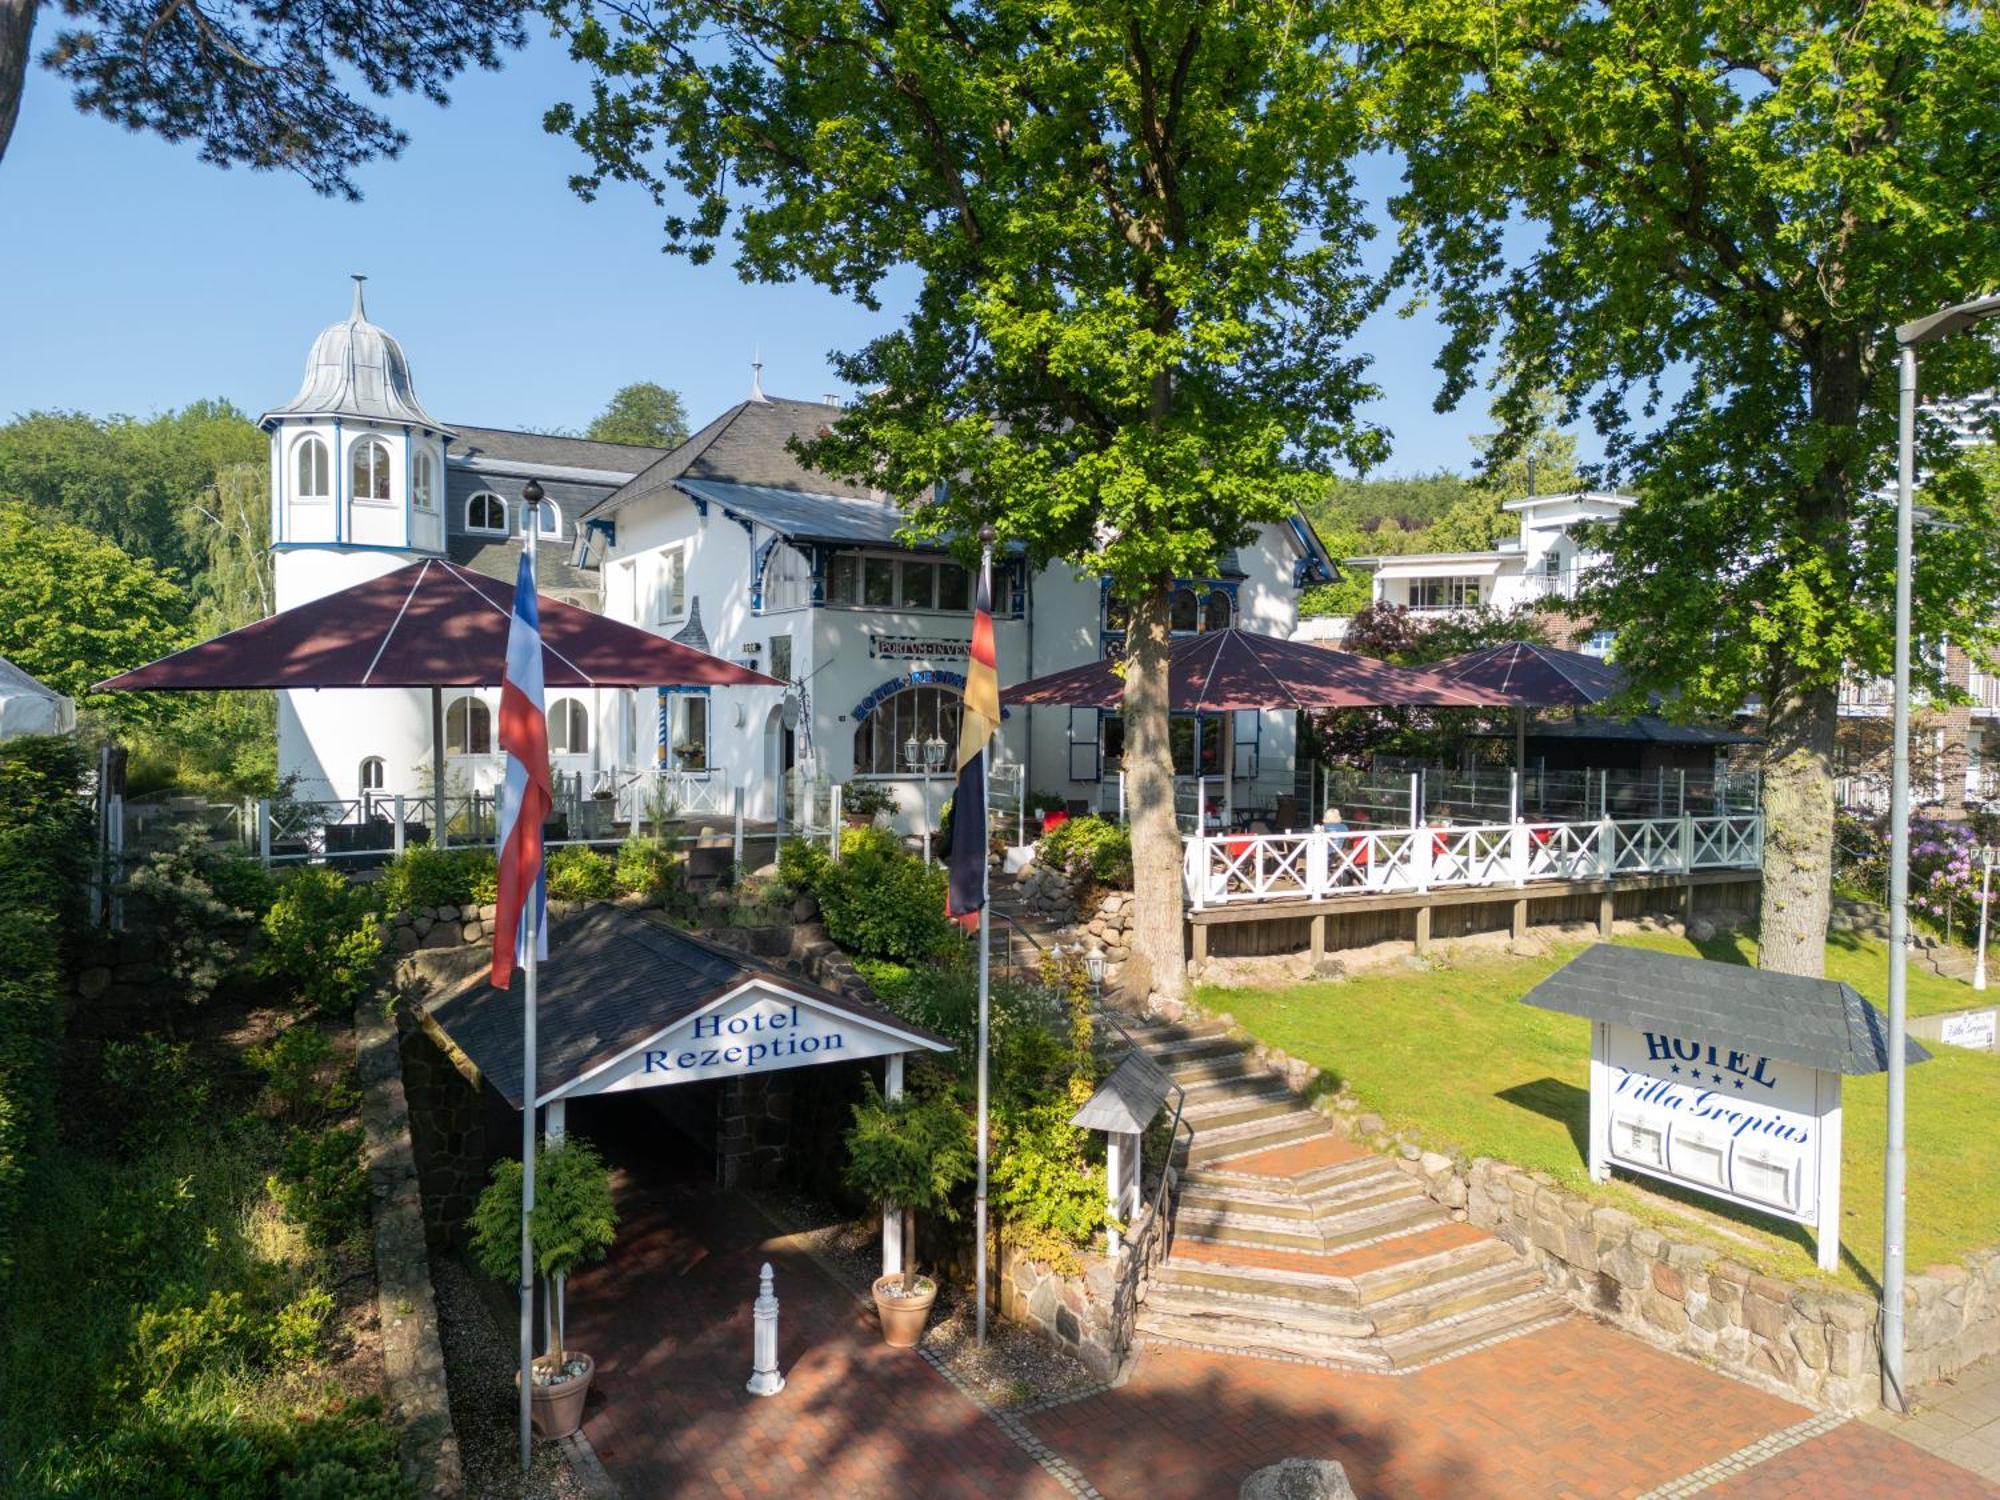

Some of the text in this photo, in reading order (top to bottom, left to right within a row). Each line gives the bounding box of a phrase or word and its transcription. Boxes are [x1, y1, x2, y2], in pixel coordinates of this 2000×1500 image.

[934, 643, 972, 657] INVEN
[851, 677, 906, 722] HOTEL
[692, 1005, 801, 1041] Hotel
[641, 1032, 846, 1075] Rezeption
[1642, 1031, 1777, 1090] HOTEL
[1614, 1066, 1684, 1111] Villa
[1689, 1086, 1809, 1145] Gropius
